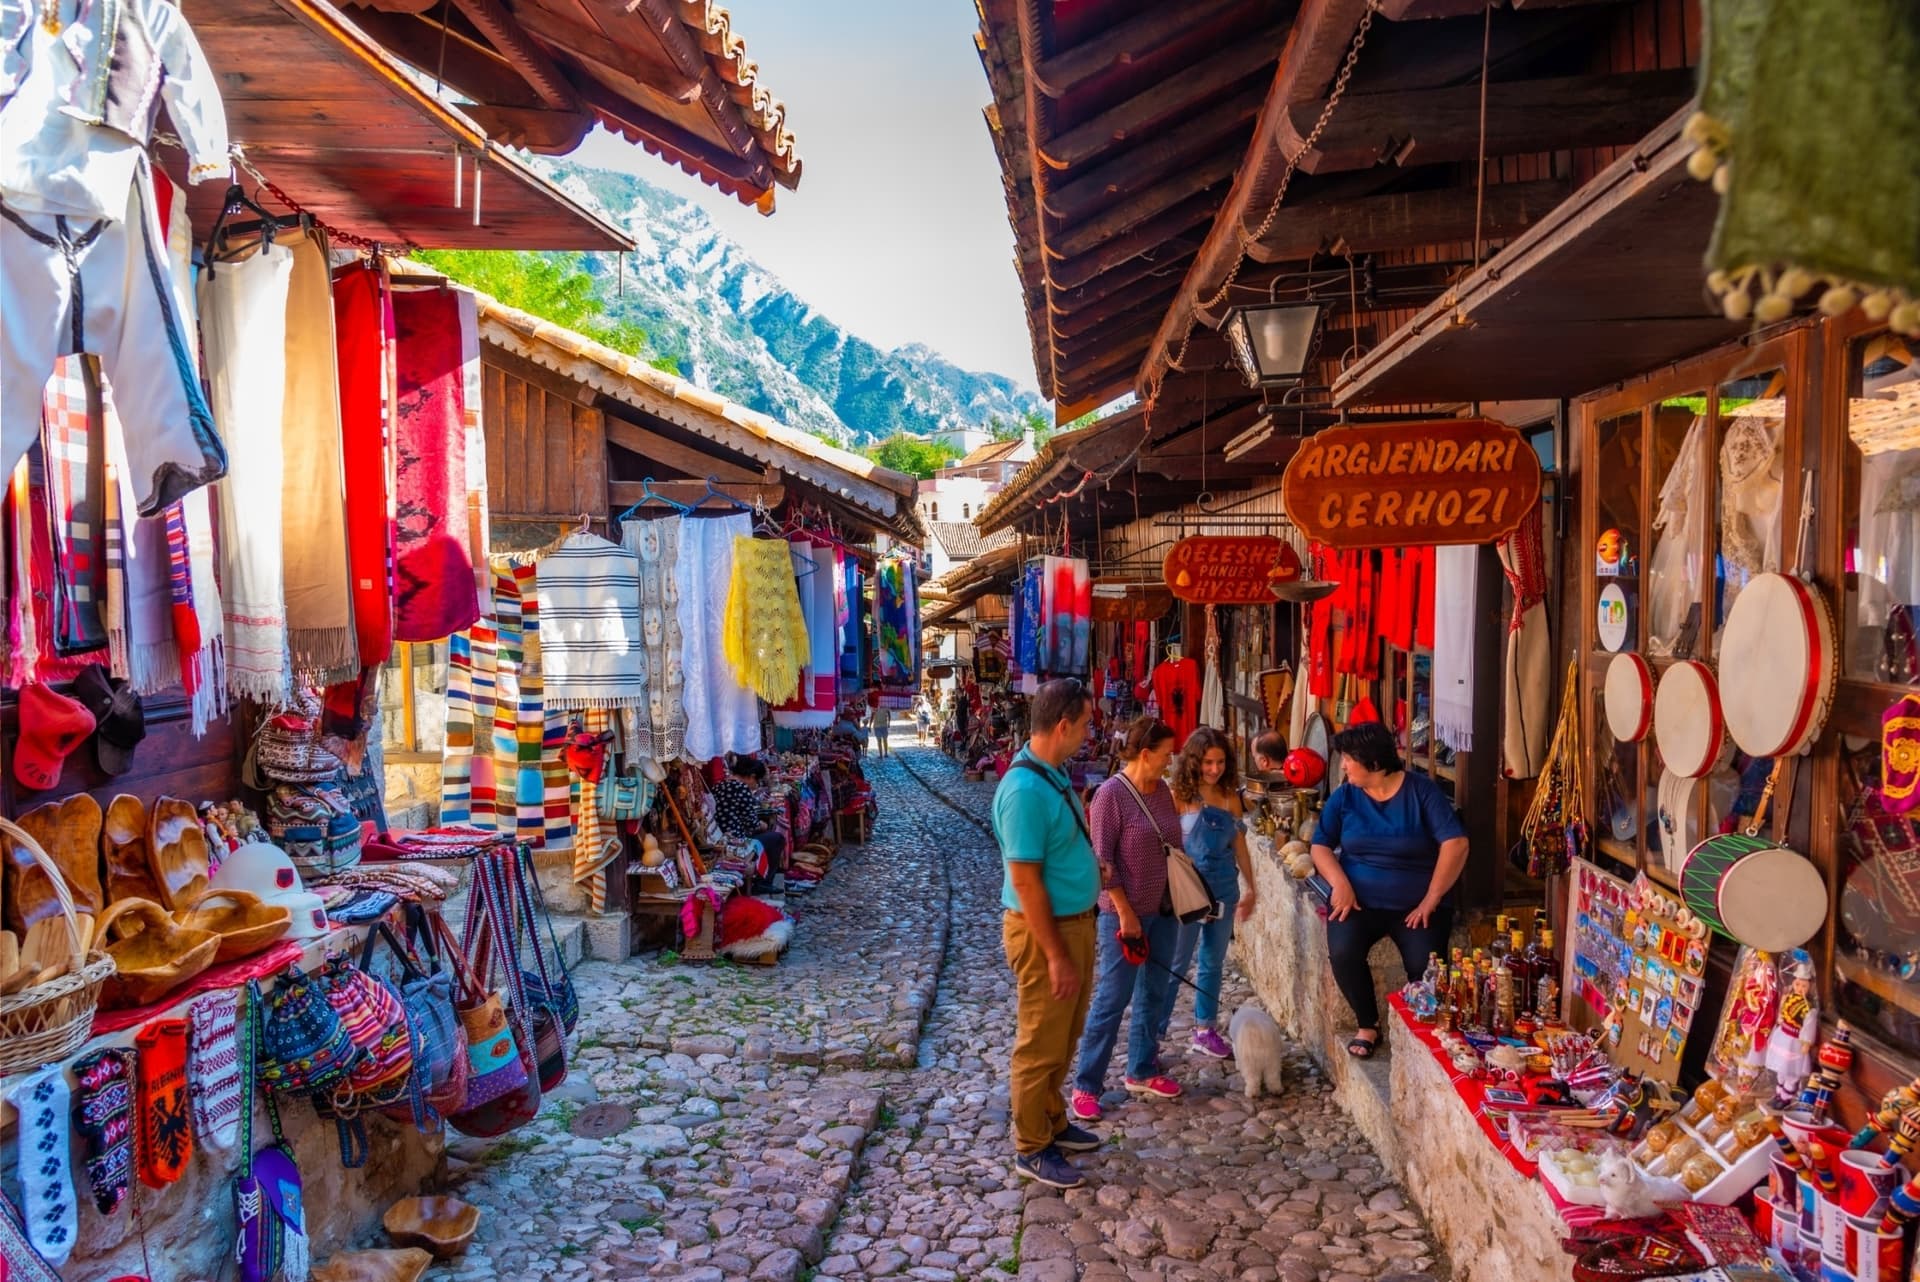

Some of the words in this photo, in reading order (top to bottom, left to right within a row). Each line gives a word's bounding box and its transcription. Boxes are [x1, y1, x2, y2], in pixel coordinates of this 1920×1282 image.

[1300, 438, 1518, 479] ARGJENDARI
[1319, 487, 1509, 529] CERHOZI
[1179, 543, 1280, 566] QELESHE
[1200, 564, 1255, 578] PUNUES
